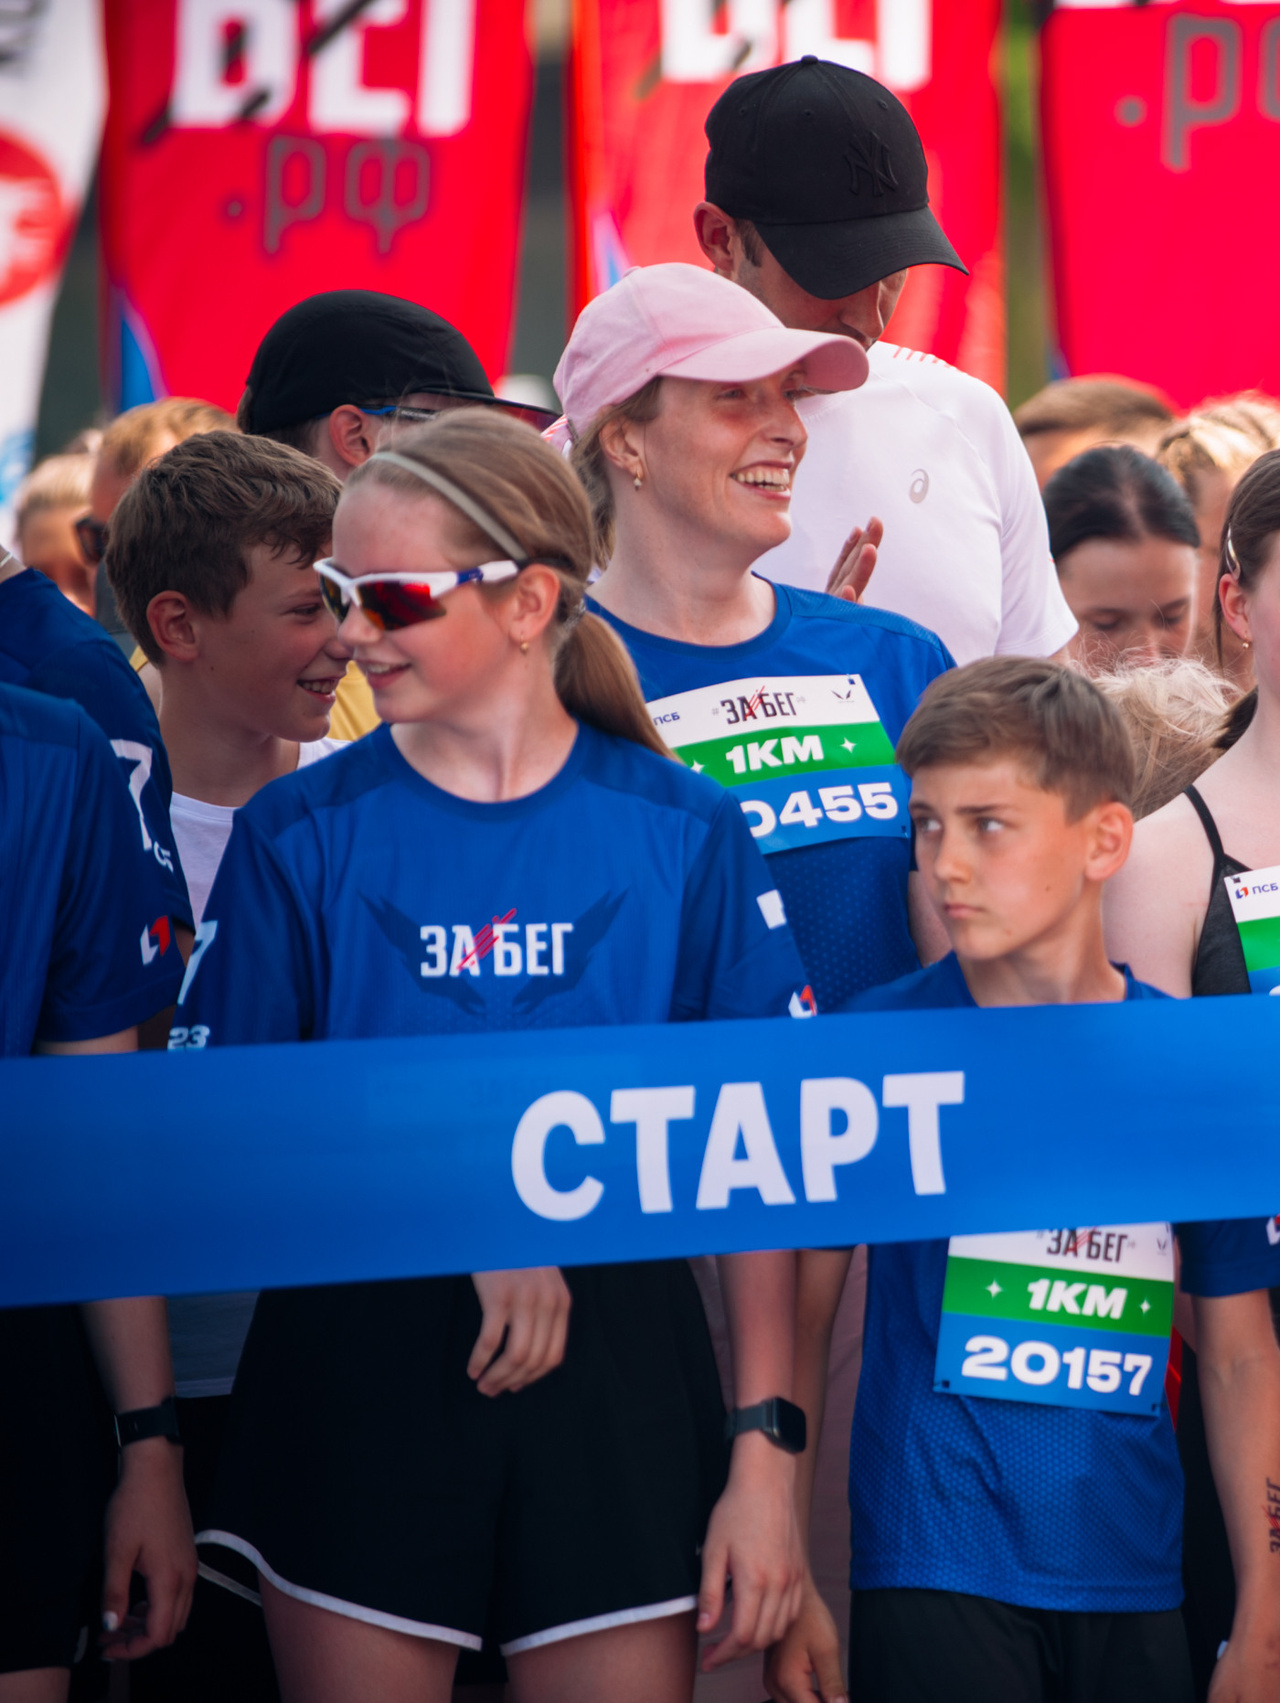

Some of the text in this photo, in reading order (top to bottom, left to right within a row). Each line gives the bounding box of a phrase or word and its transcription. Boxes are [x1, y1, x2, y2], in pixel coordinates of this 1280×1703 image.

[740, 782, 899, 838] 0455
[1252, 882, 1279, 894] ПСБ
[511, 1071, 965, 1221] СТАРТ
[961, 1335, 1153, 1396] 20157
